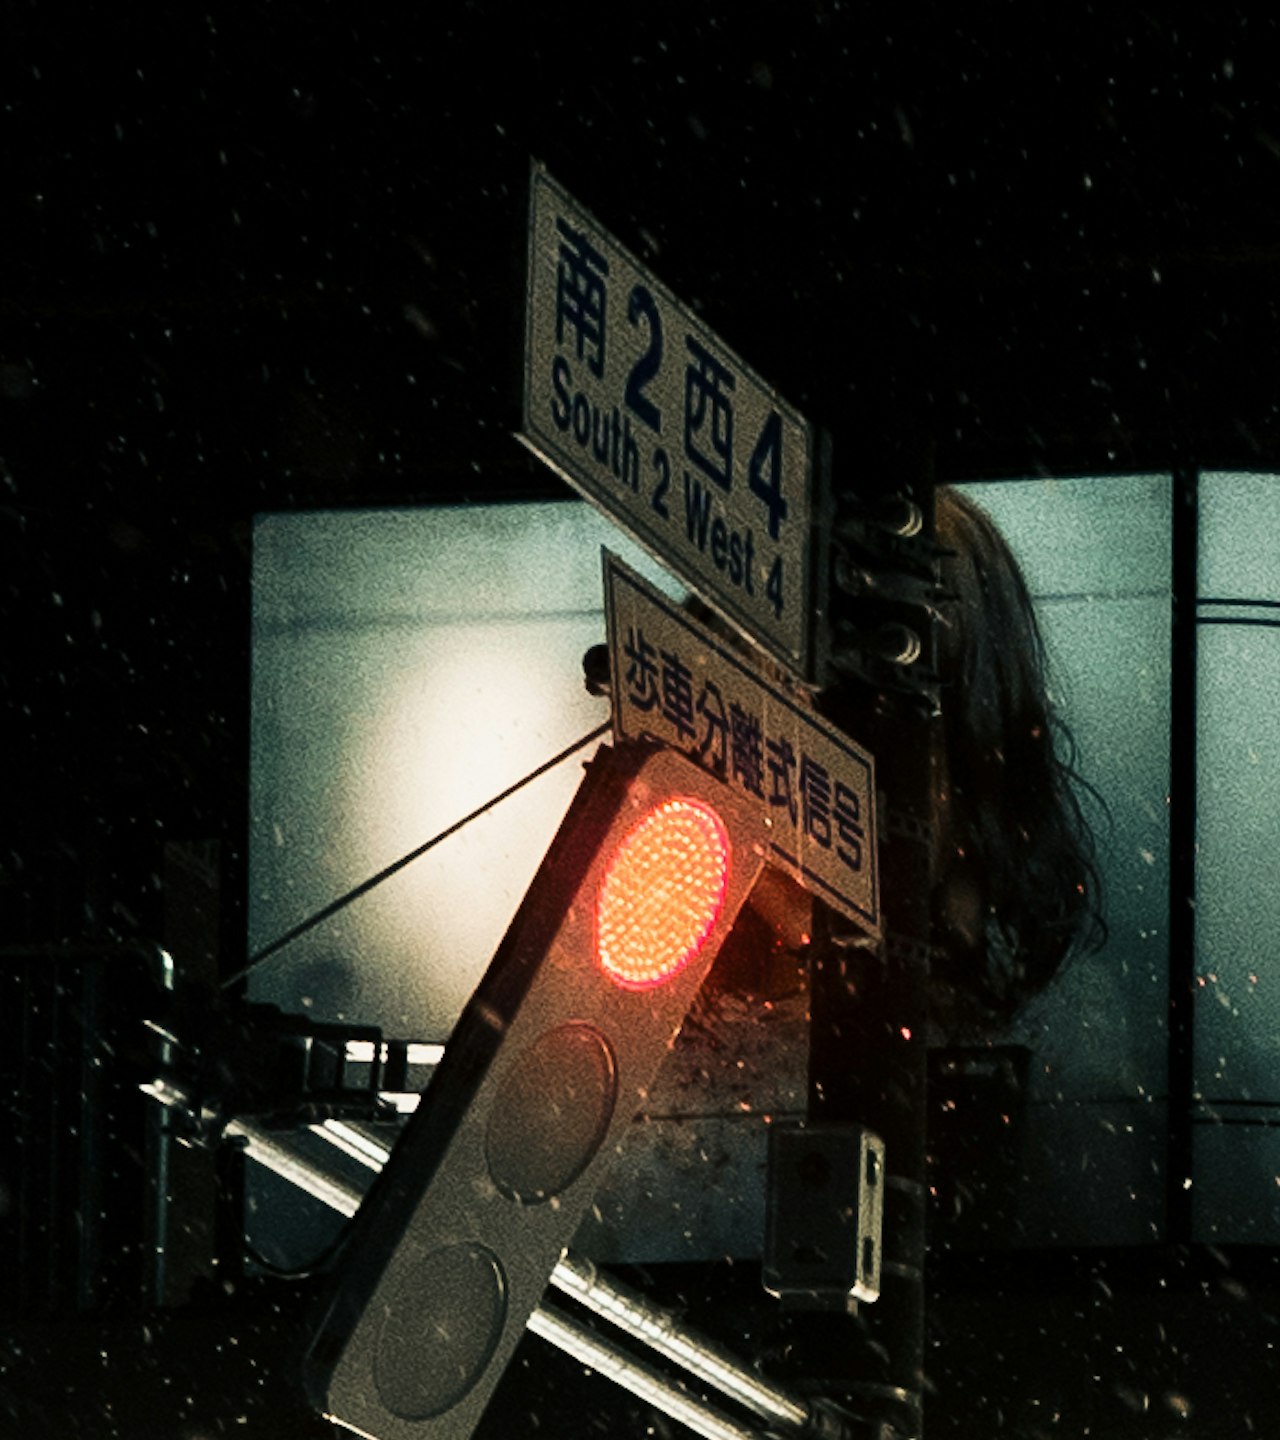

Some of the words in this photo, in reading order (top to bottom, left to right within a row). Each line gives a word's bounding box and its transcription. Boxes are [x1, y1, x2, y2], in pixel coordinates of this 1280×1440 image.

[551, 356, 641, 495] South
[651, 451, 671, 522] 2
[683, 466, 757, 599] West
[765, 555, 786, 620] 4
[554, 216, 787, 542] 南2西4
[624, 627, 865, 875] 歩車分離式信号
